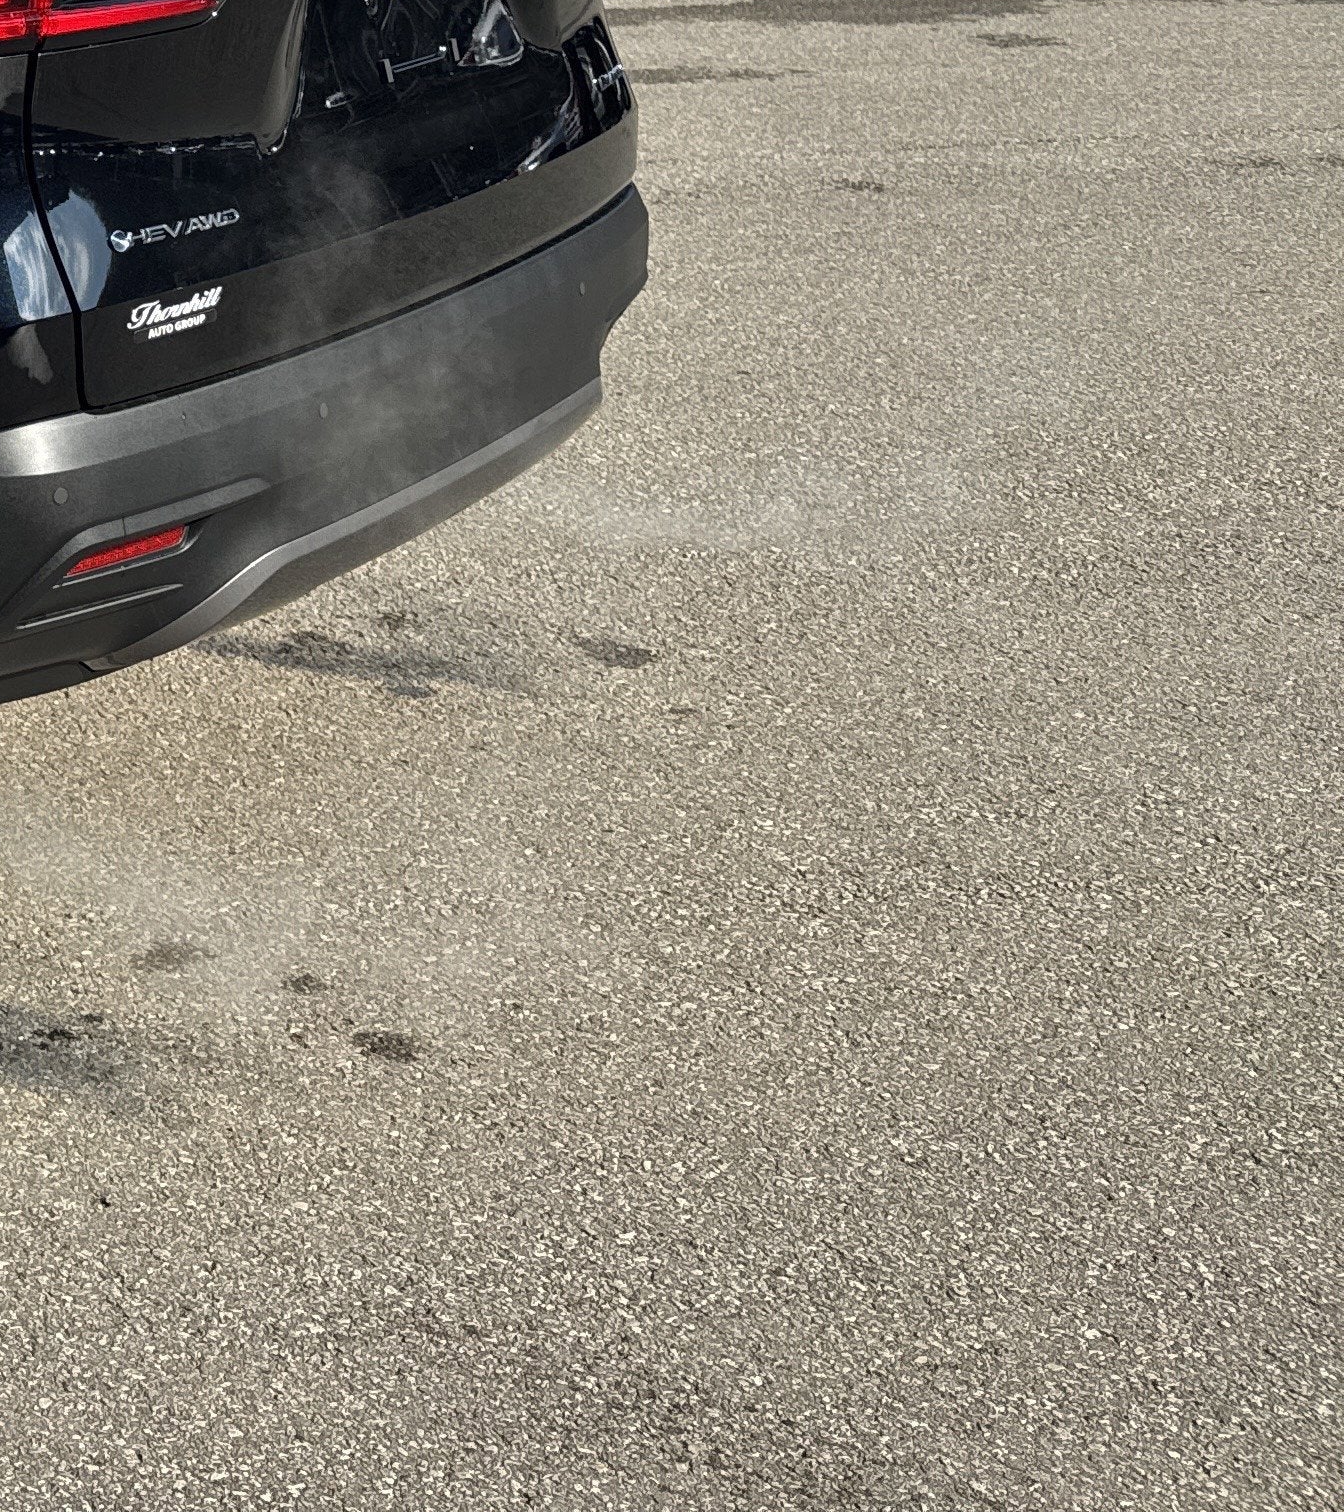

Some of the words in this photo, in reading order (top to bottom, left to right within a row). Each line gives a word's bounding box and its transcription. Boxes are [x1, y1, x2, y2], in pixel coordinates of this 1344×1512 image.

[184, 207, 240, 236] AWD
[126, 286, 223, 329] Thornhill
[147, 321, 174, 340] AUTO
[174, 313, 207, 332] GROUP
